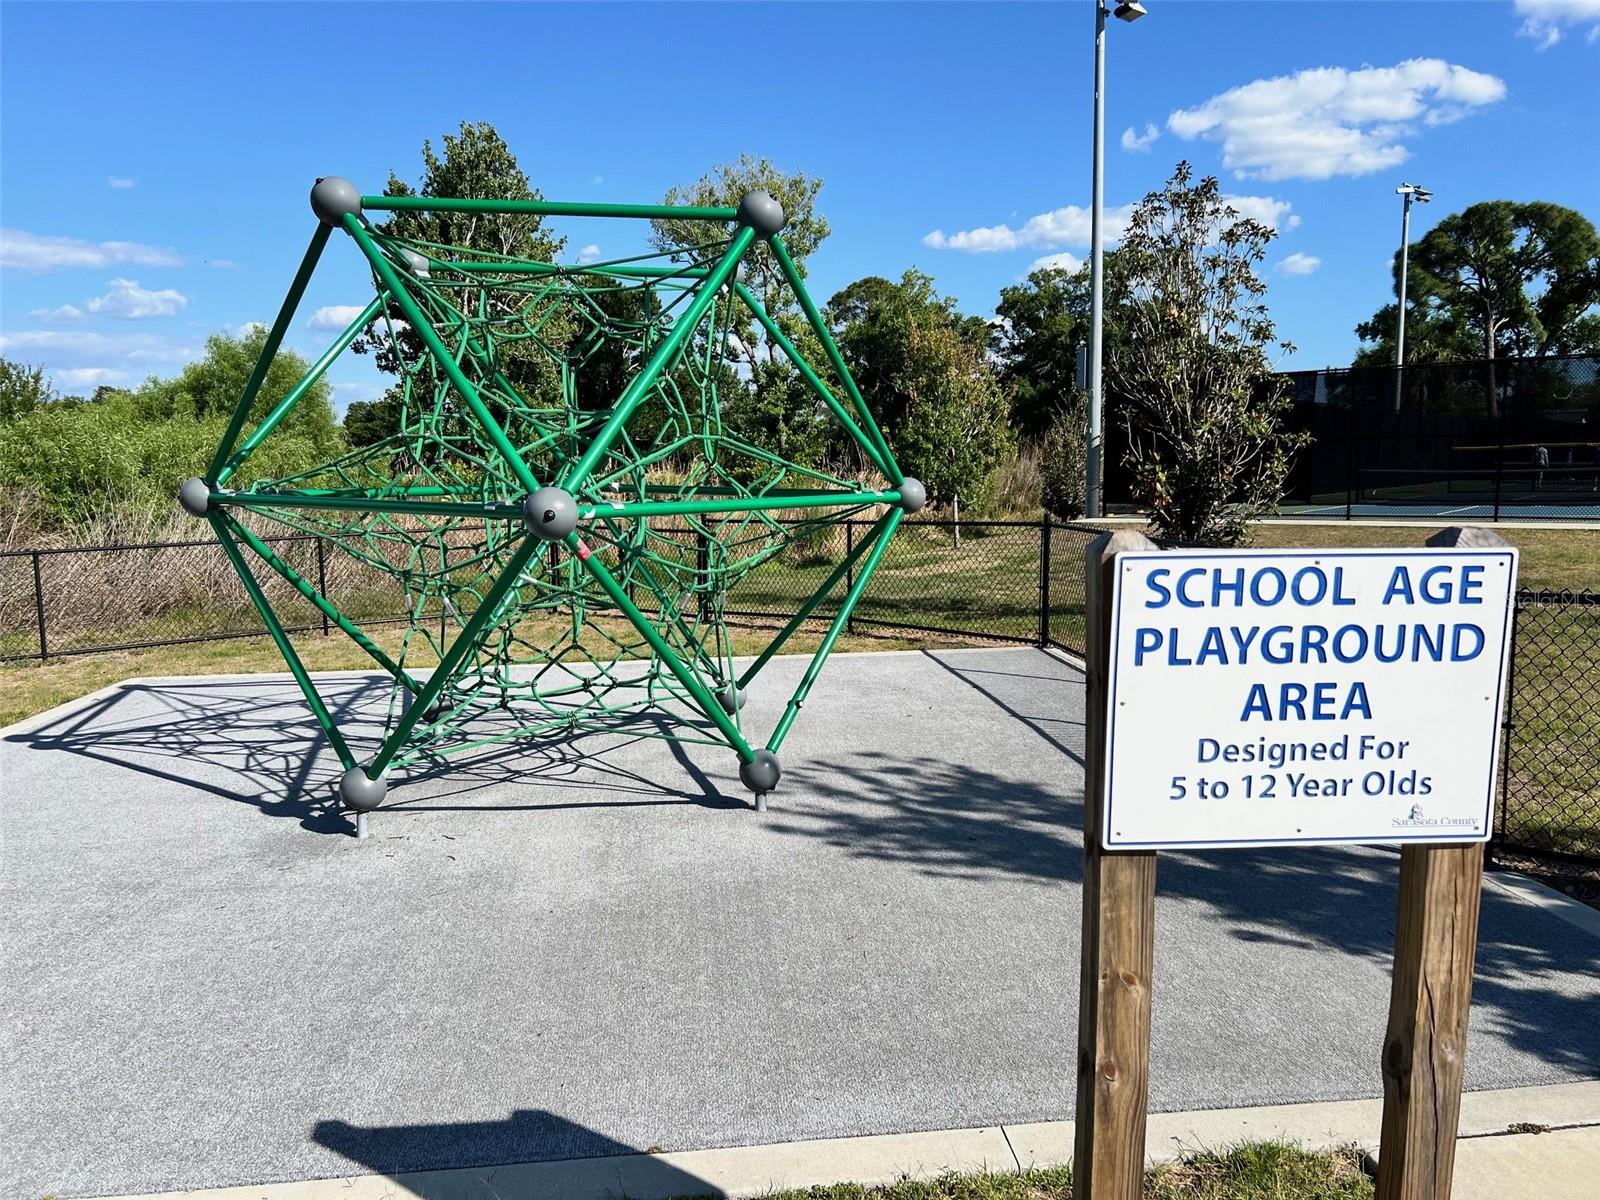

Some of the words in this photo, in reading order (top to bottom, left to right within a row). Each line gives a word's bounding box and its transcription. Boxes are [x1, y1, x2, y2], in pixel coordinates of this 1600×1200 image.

[1144, 566, 1356, 609] SCHOOL
[1382, 565, 1485, 606] AGE
[1134, 623, 1486, 667] PLAYGROUND
[1240, 681, 1373, 722] AREA
[1198, 735, 1349, 769] Designed
[1359, 735, 1410, 760] For
[1169, 777, 1187, 800] 5
[1196, 777, 1230, 800] to
[1240, 774, 1277, 799] 12
[1286, 773, 1354, 799] Year
[1362, 770, 1433, 796] Olds
[1440, 816, 1479, 826] County
